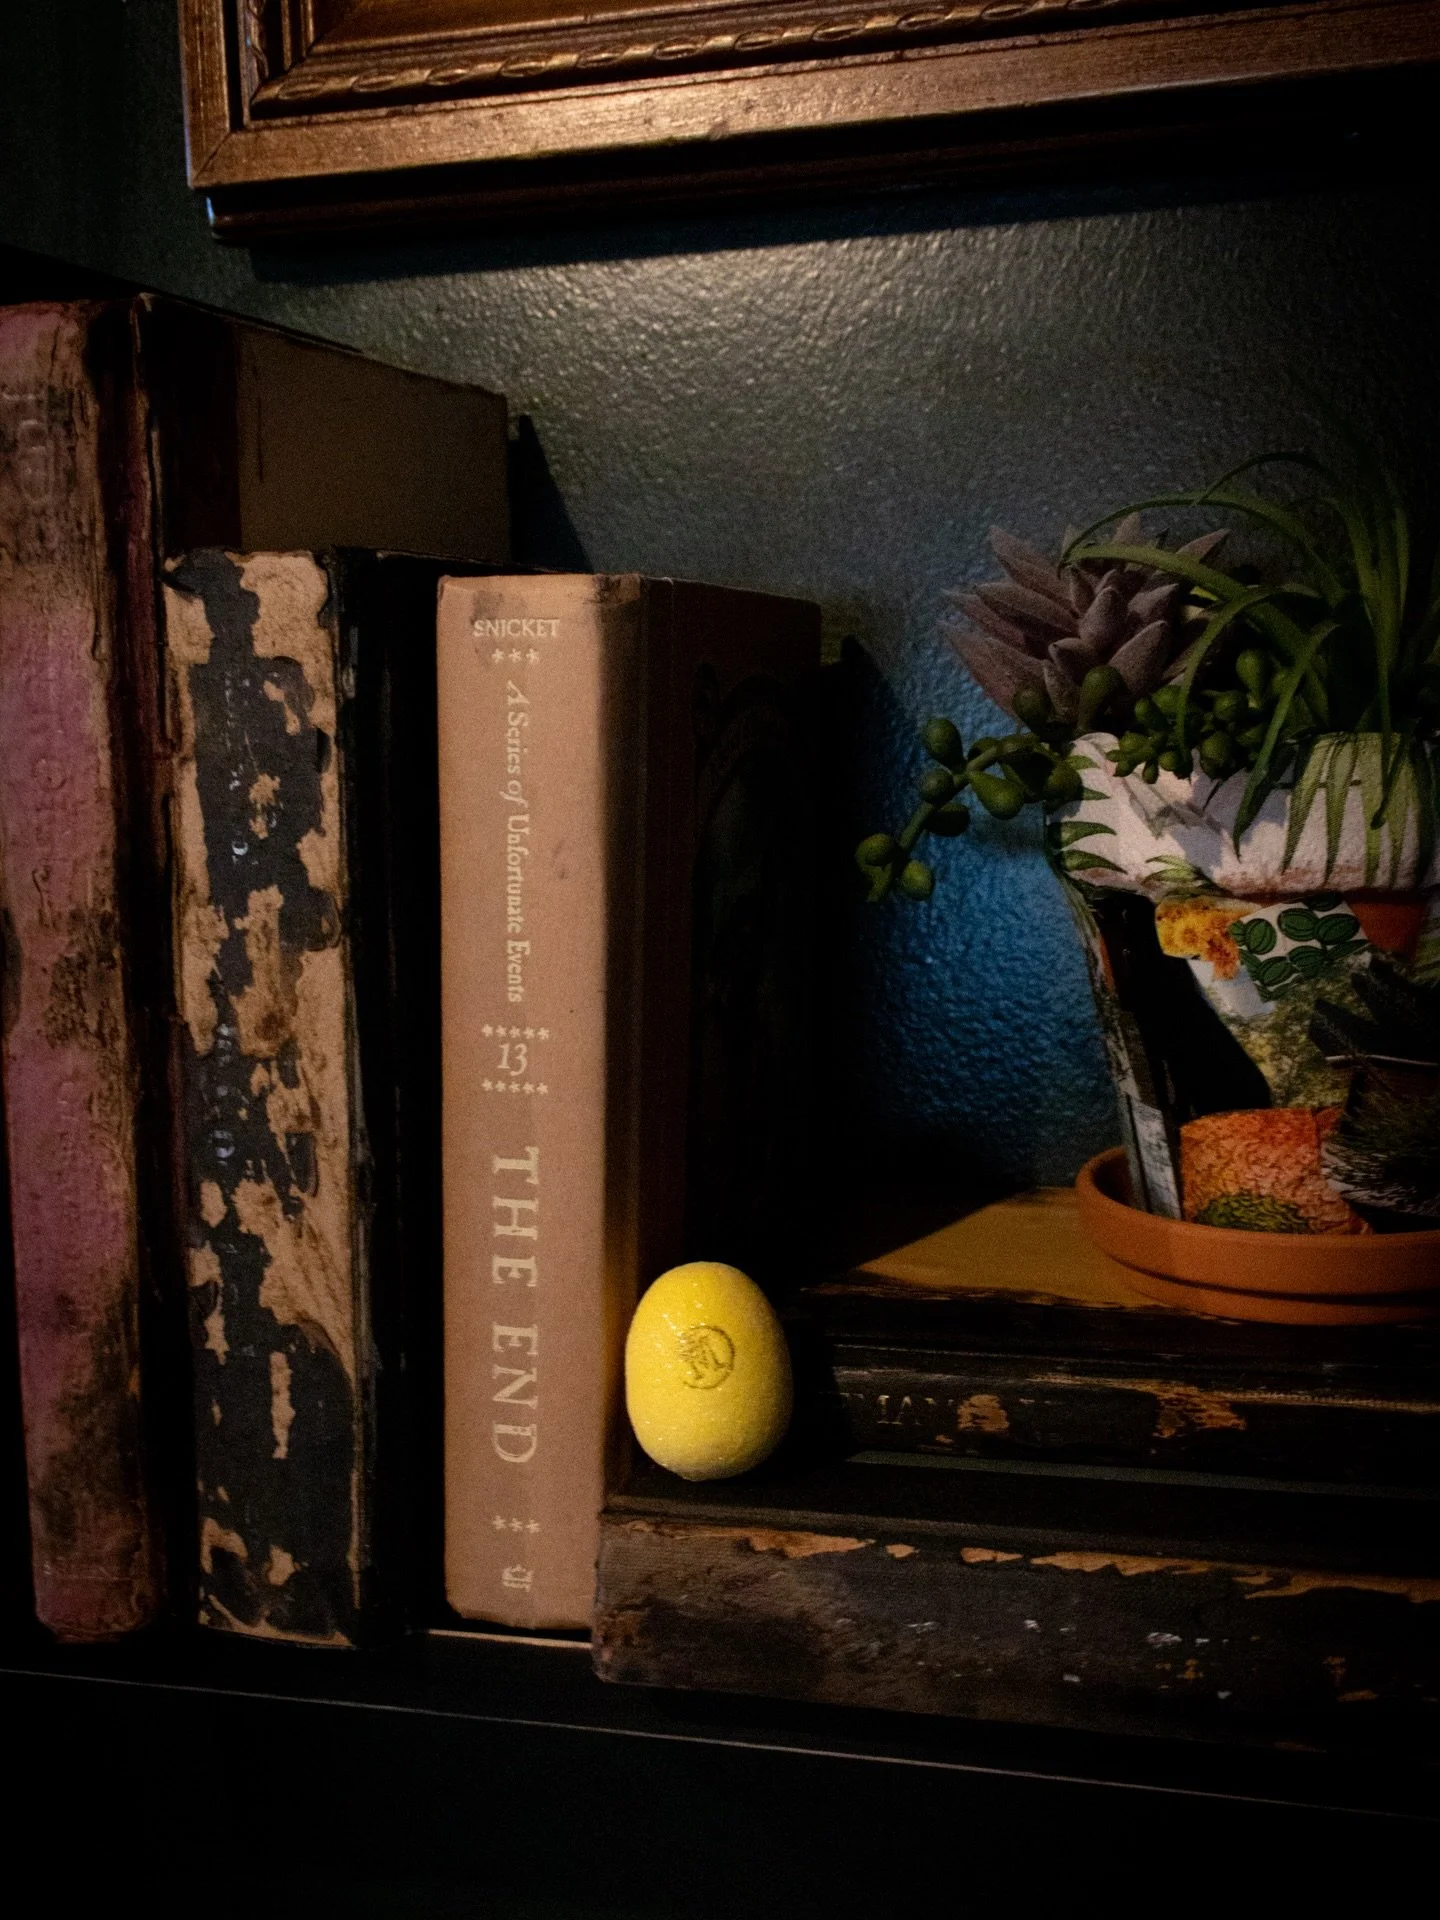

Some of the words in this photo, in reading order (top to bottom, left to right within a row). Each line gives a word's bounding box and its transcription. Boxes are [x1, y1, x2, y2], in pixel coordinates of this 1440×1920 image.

[473, 618, 560, 638] SNICKET
[505, 678, 530, 708] A
[506, 711, 530, 776] Series
[499, 779, 528, 811] of
[507, 814, 530, 934] Unfortunate
[507, 938, 531, 1004] Events
[496, 1043, 529, 1076] 13
[491, 1145, 539, 1288] THE
[491, 1323, 539, 1464] END
